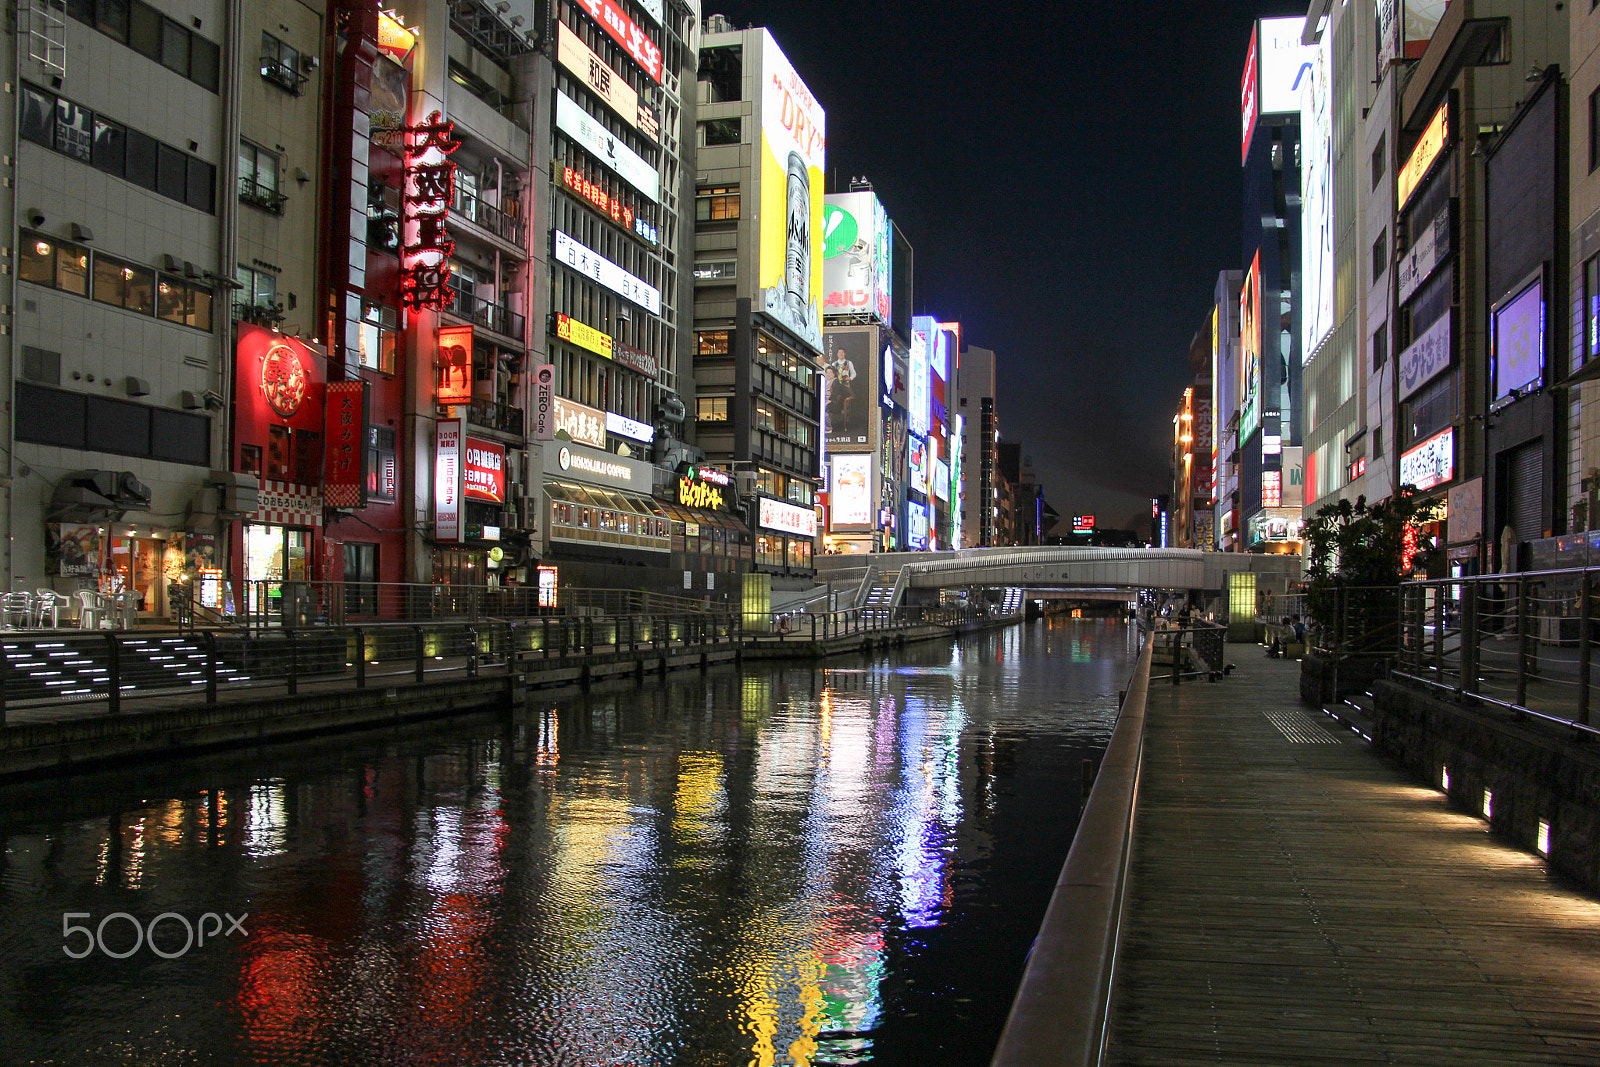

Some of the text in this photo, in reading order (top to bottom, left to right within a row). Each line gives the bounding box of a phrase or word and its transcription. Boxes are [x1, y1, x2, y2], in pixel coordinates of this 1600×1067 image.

[588, 57, 610, 96] 和民
[790, 72, 813, 113] SUPER
[404, 110, 461, 314] 大阪王将
[788, 209, 809, 256] Asahi
[568, 242, 602, 280] 白木屋
[622, 274, 651, 308] 白木屋
[538, 385, 548, 412] ZERO
[340, 394, 354, 472] 大阪みやげ
[571, 454, 632, 480] HONOLULU COFFEE
